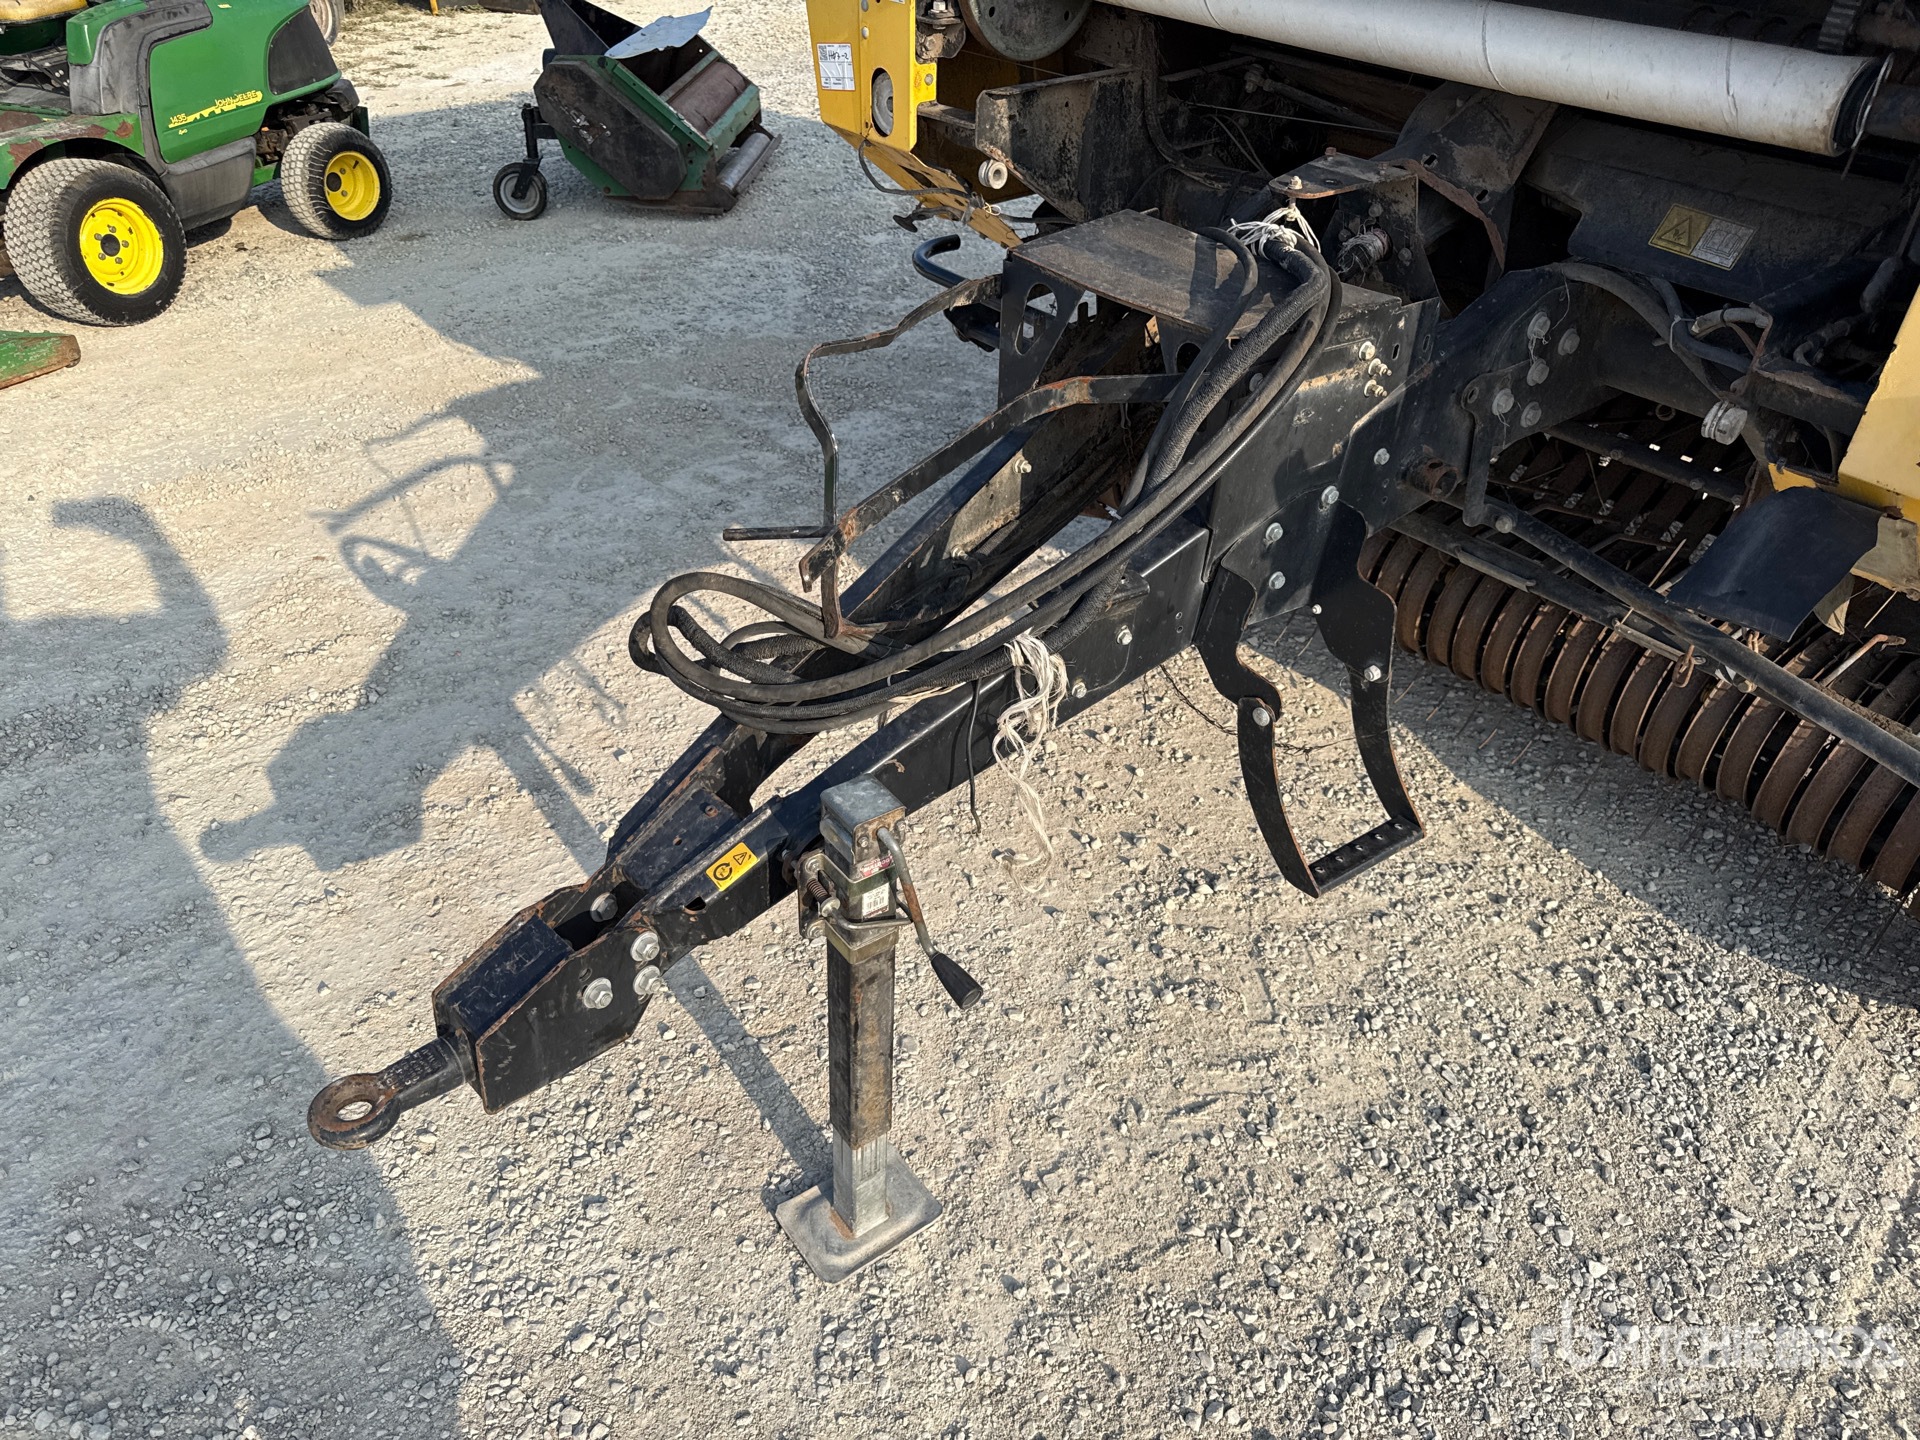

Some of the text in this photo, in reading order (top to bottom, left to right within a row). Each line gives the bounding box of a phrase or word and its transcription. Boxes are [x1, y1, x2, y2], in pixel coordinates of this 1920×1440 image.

[214, 90, 258, 109] JOHN DEERE
[169, 113, 187, 125] 1435
